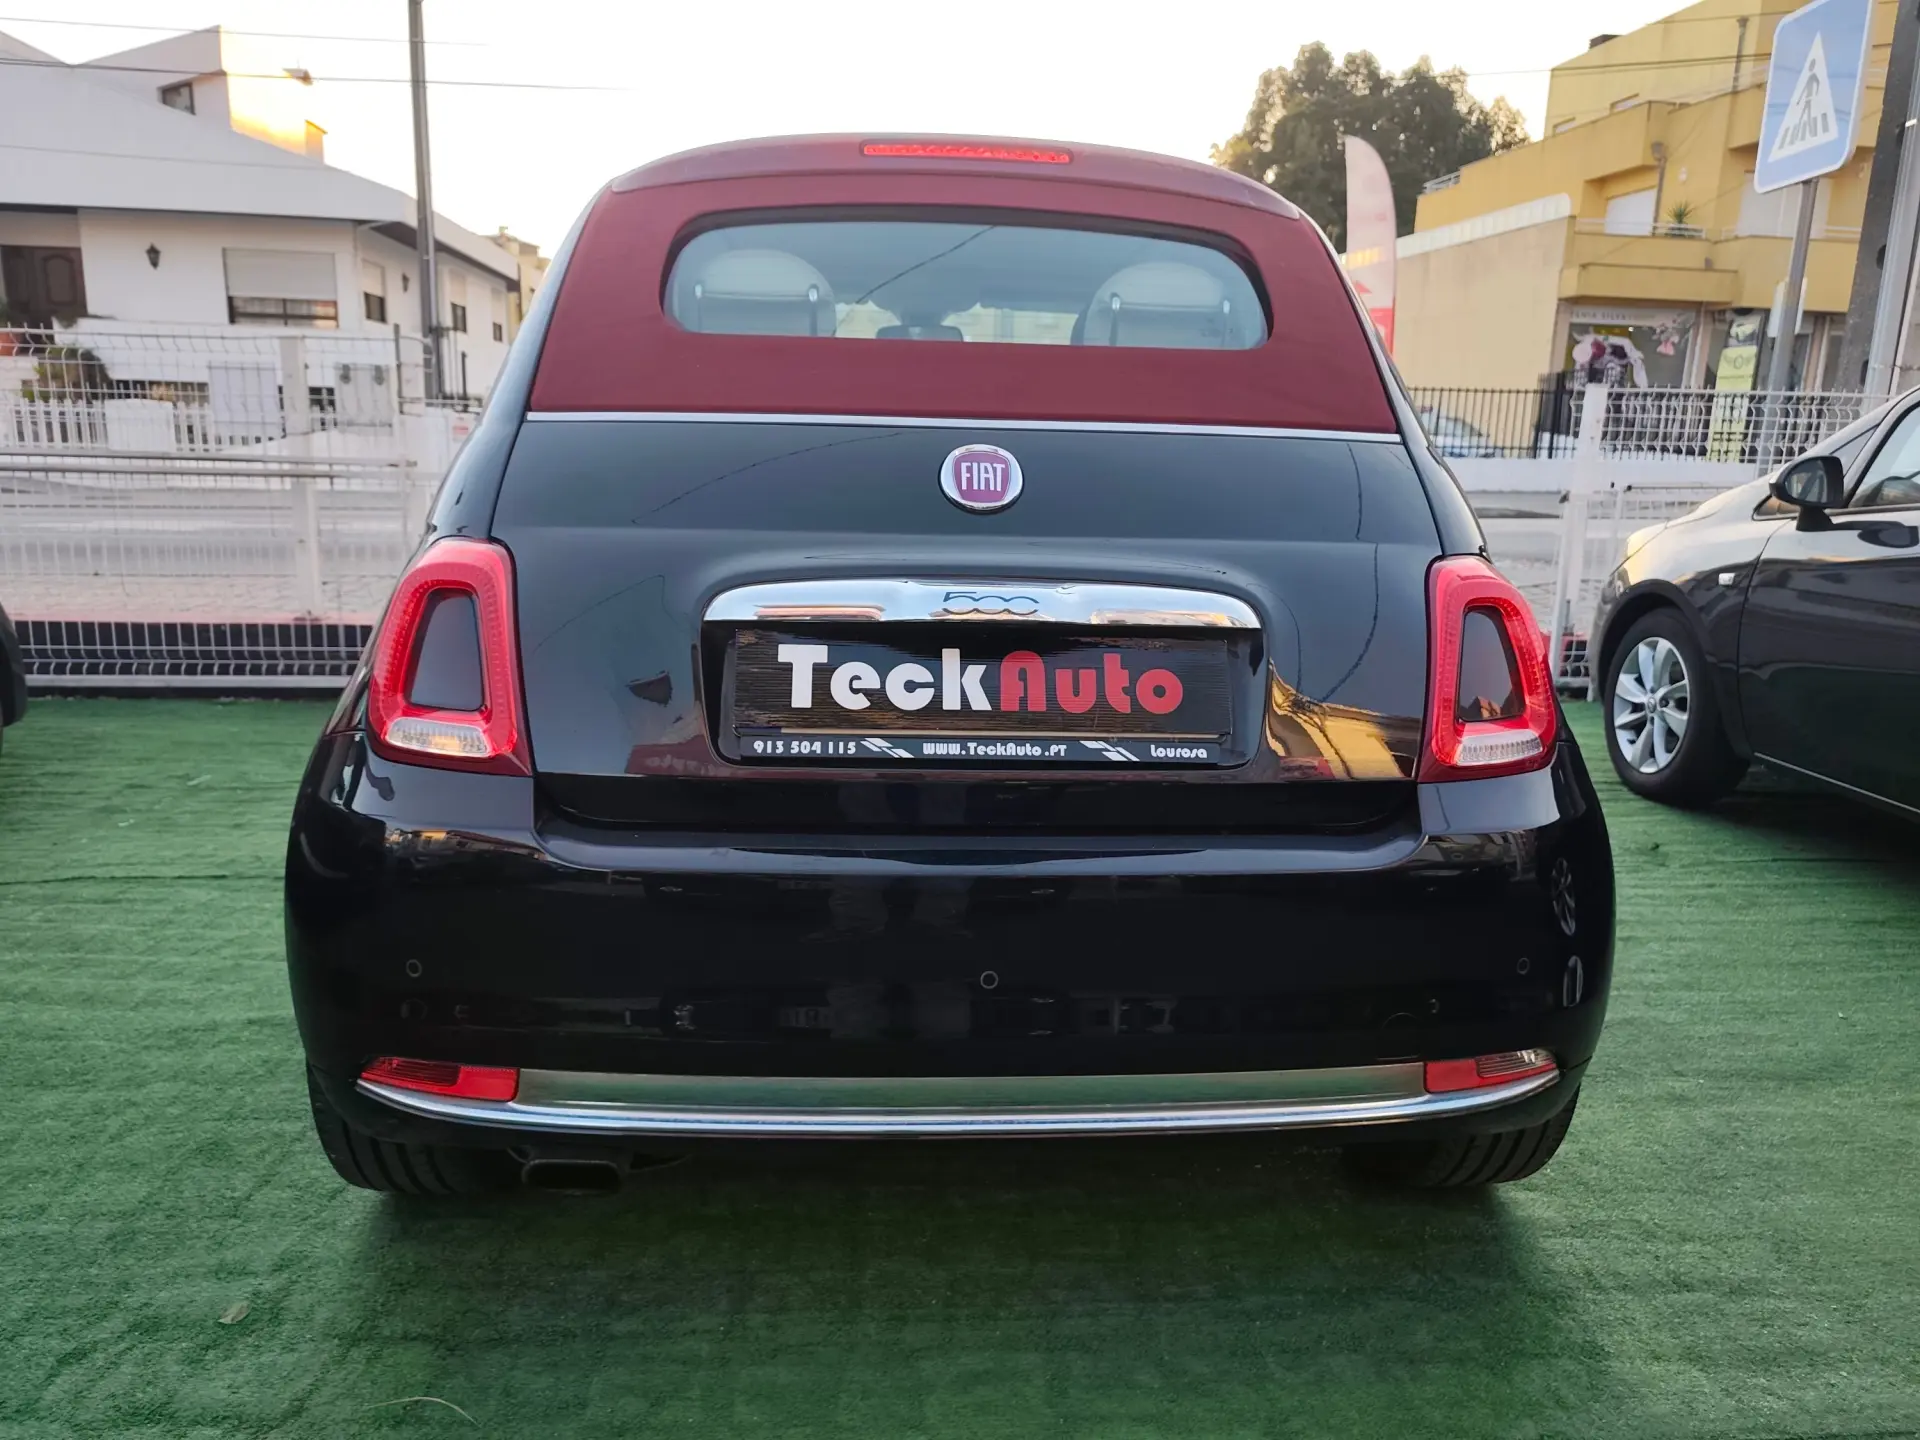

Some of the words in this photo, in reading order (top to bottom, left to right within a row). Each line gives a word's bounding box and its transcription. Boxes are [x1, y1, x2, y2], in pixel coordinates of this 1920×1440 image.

[960, 461, 1006, 492] FIAT
[942, 591, 1039, 616] 500
[777, 644, 1184, 715] TeckAuto
[753, 740, 784, 754] 913
[790, 740, 822, 755] 504
[828, 741, 856, 755] 115
[1150, 744, 1208, 759] Lourosa
